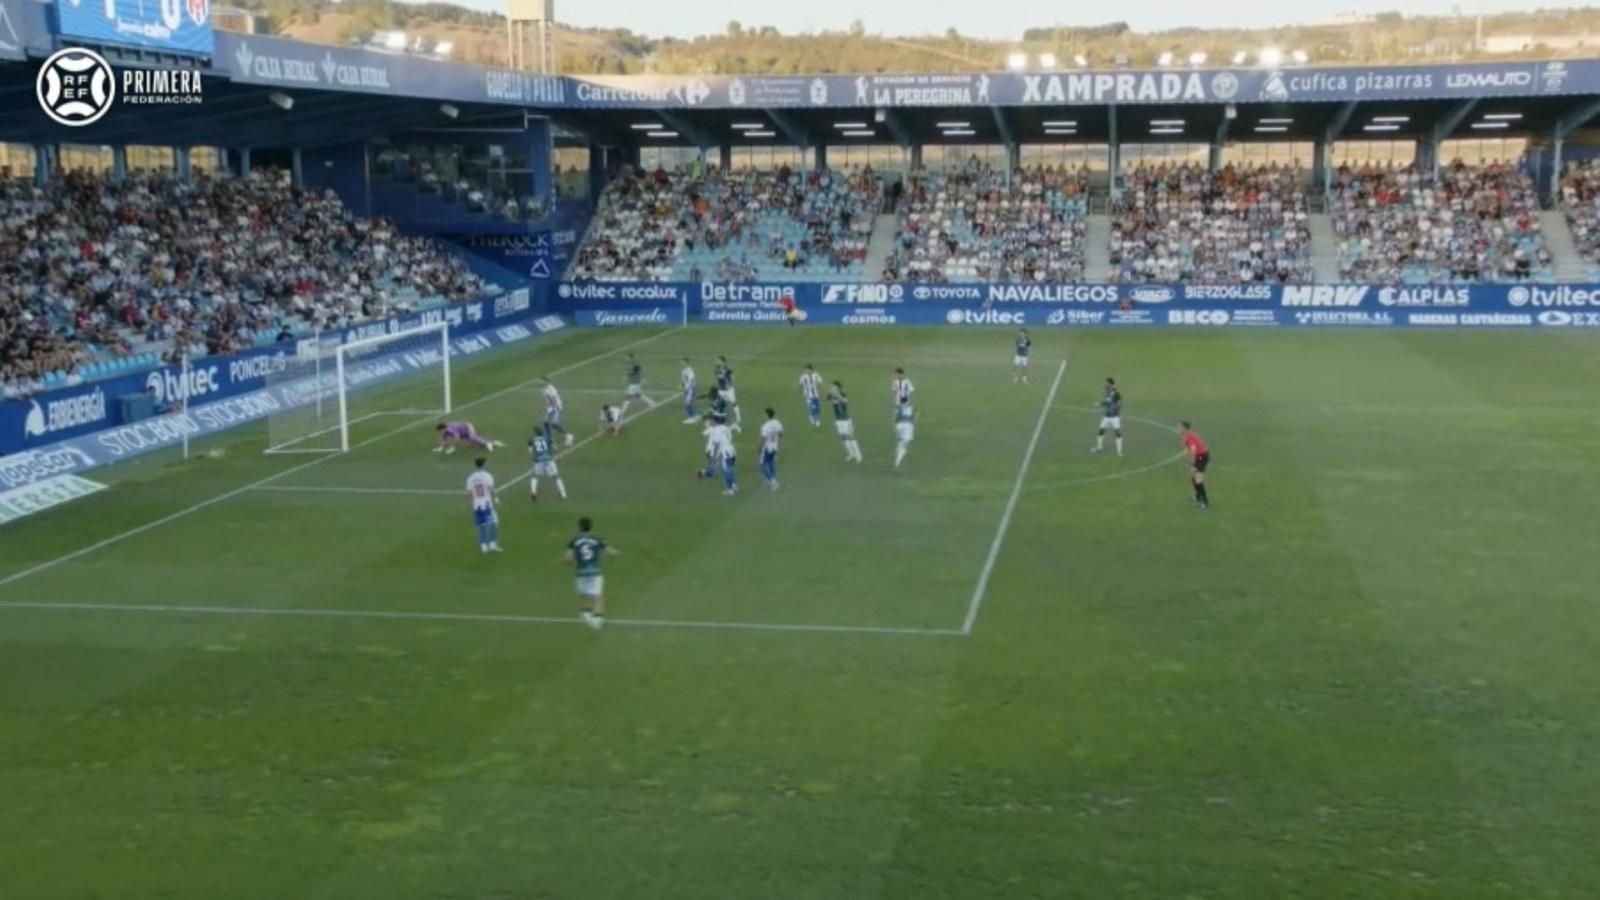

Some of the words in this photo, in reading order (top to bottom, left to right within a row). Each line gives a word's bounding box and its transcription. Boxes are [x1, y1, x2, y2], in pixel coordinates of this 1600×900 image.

[1023, 73, 1206, 102] XAMPRADA
[1290, 73, 1348, 91] cufica
[1355, 72, 1433, 94] pizarras
[874, 88, 890, 105] LA
[895, 88, 971, 105] PEREGRINA
[572, 284, 616, 299] tvitec
[932, 287, 980, 298] TOYOTA
[989, 285, 1118, 301] NAVALIEGOS
[1281, 286, 1370, 306] MRW
[965, 309, 1025, 324] tvitec
[164, 366, 219, 402] tvitec
